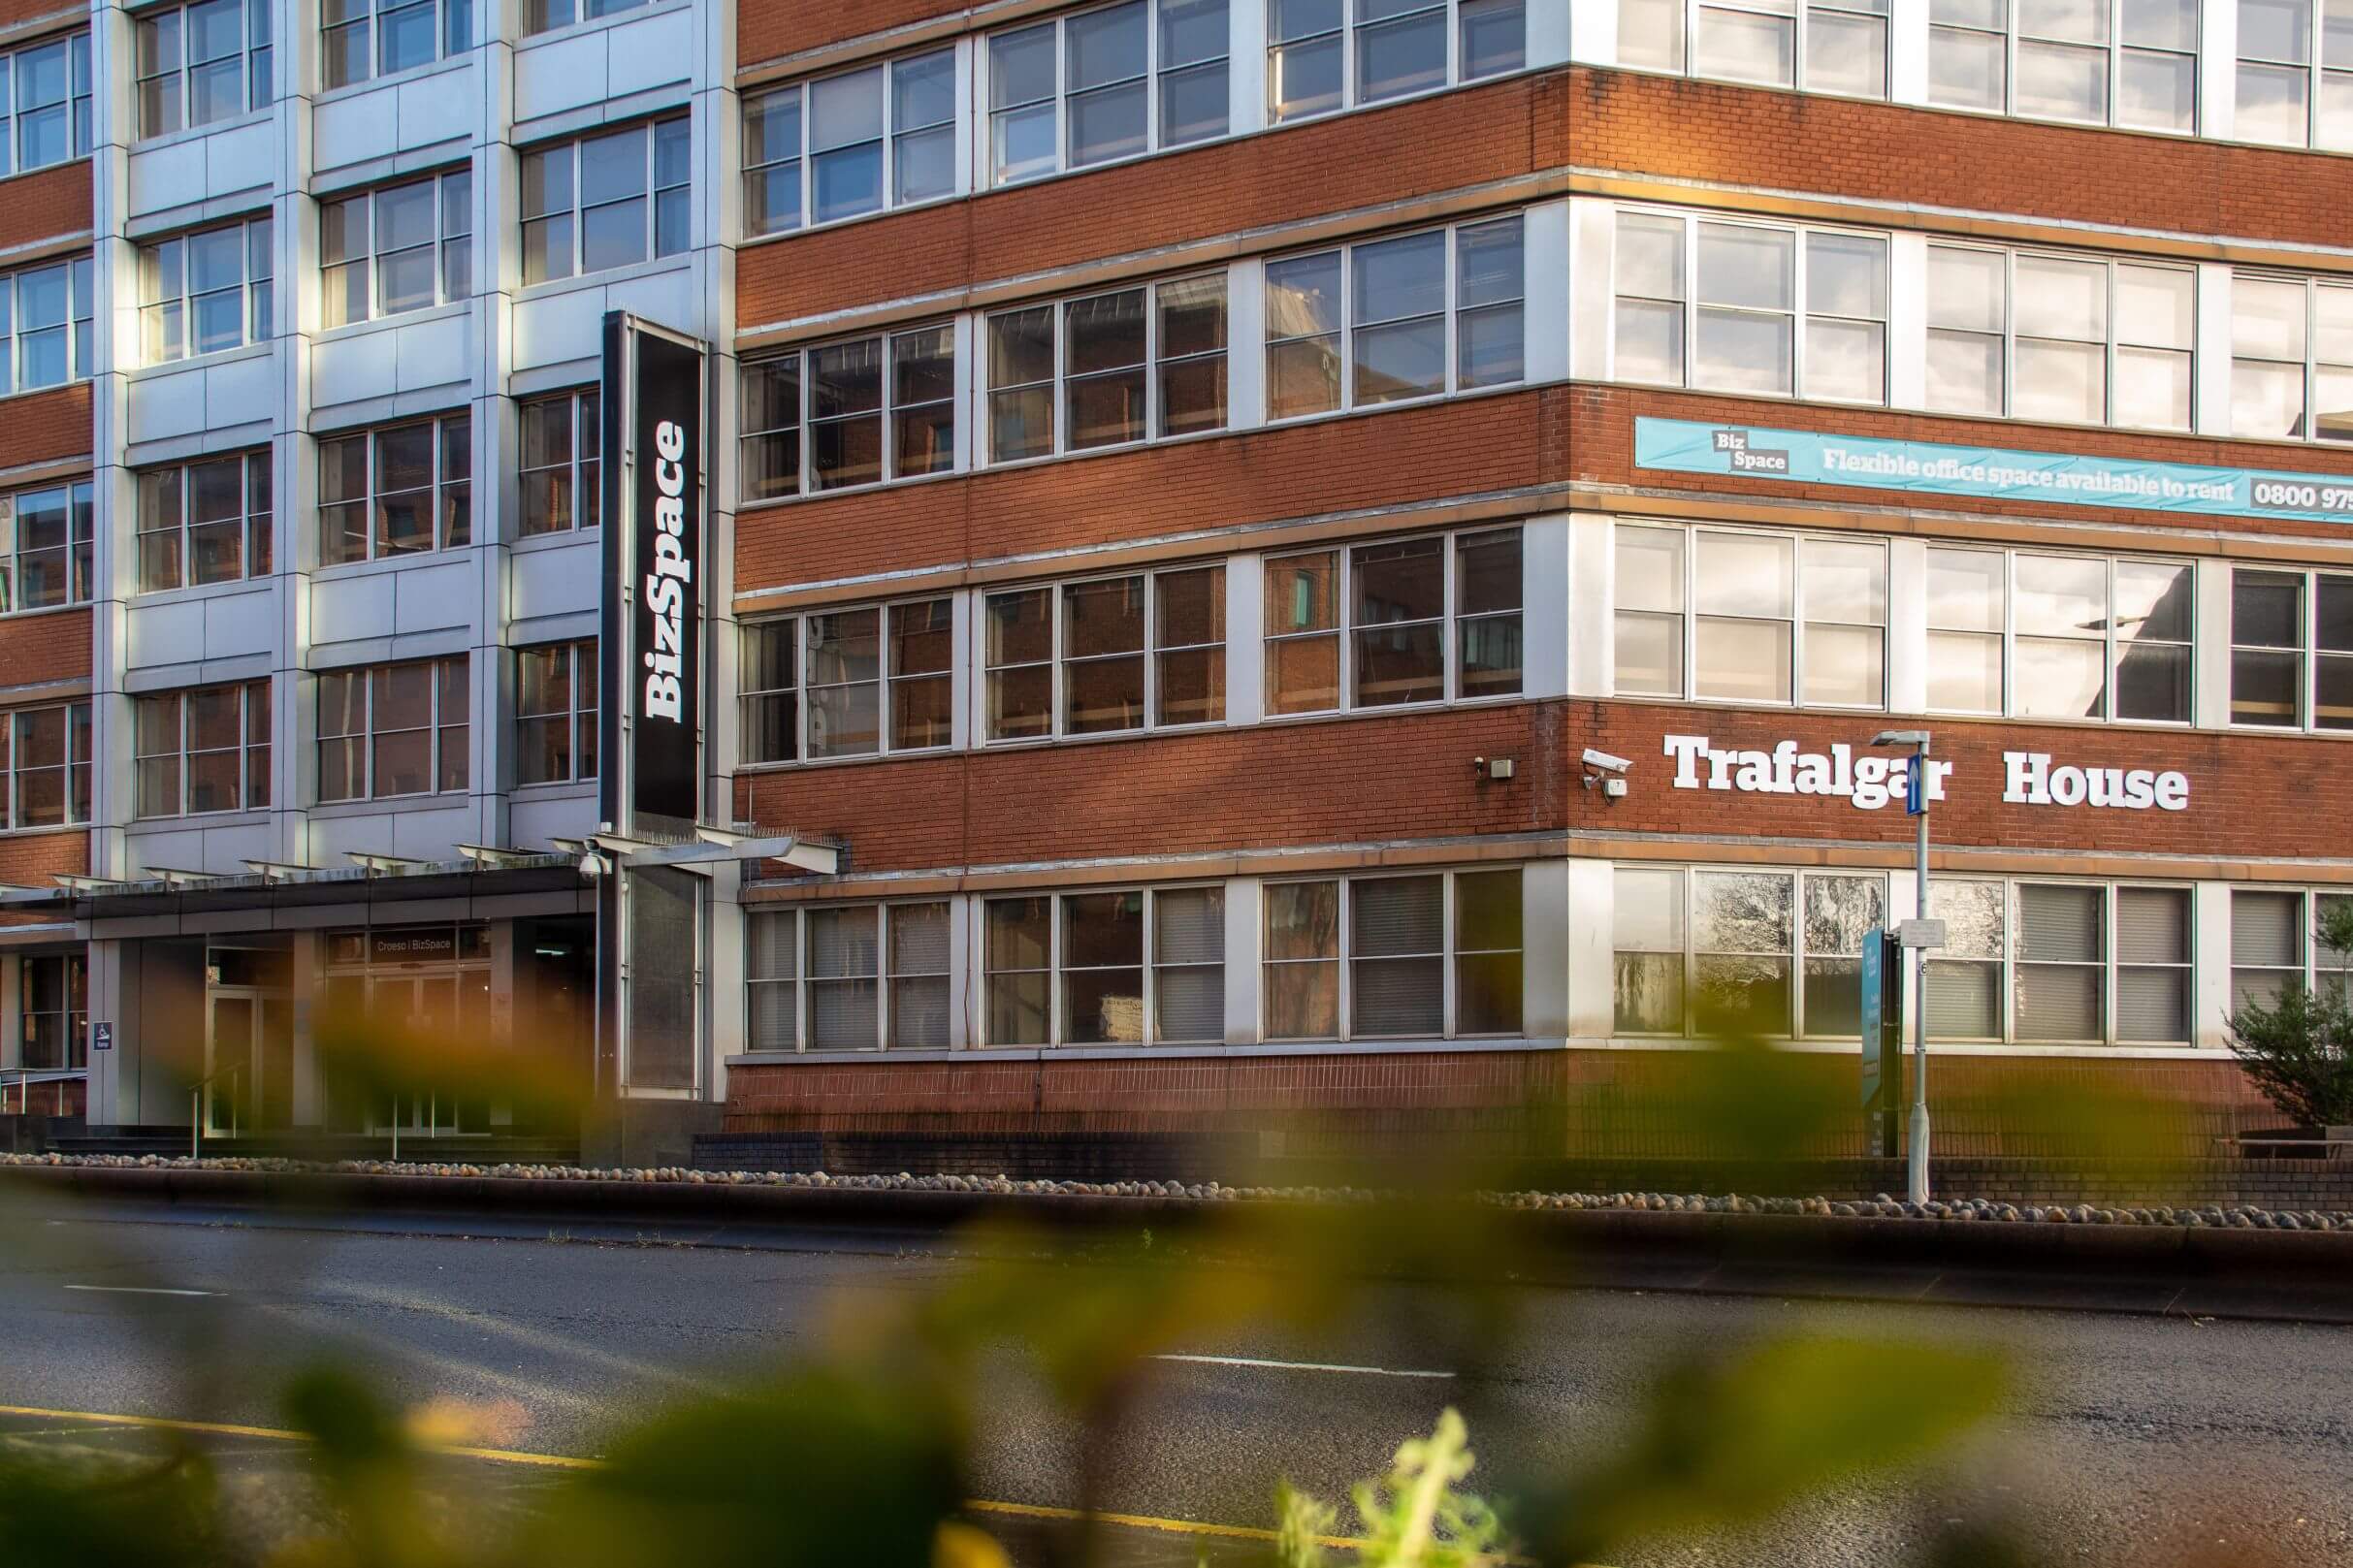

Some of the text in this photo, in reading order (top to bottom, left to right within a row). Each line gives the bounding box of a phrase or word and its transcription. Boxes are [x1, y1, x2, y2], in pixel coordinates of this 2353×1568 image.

[1717, 433, 1745, 450] Biz
[1733, 451, 1787, 470] Space
[1822, 448, 2235, 502] Flexible office space available to rent
[2254, 483, 2316, 507] 0800
[644, 421, 691, 723] BizSpace
[2002, 751, 2189, 811] House
[412, 939, 451, 952] BizSpace
